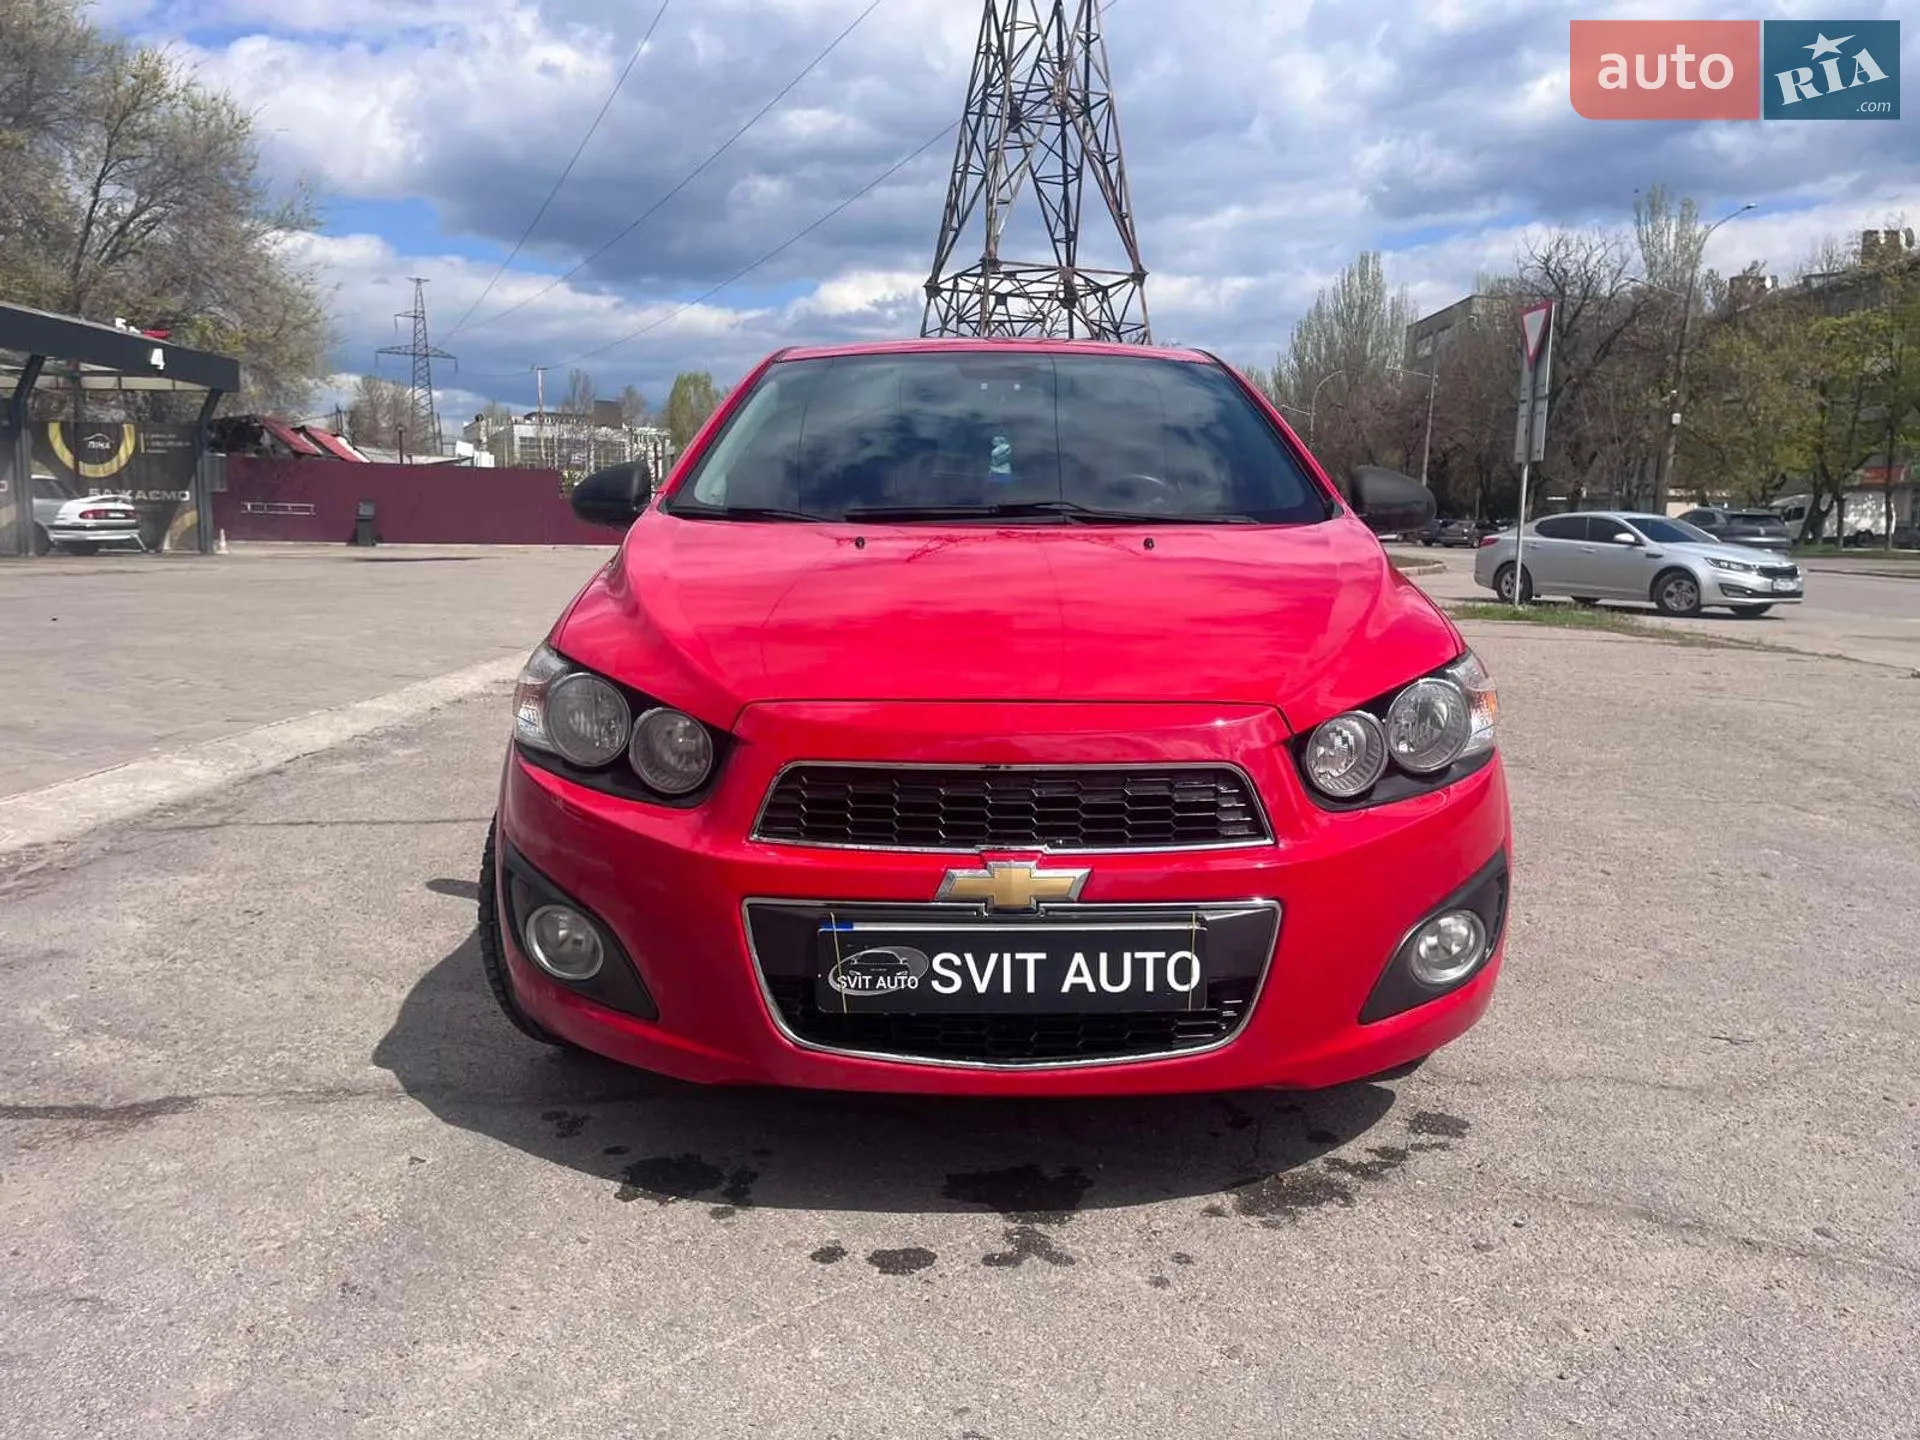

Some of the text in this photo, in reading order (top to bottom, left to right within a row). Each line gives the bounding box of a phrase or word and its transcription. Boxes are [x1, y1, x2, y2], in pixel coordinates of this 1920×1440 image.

[837, 975, 919, 990] SVIT AUTO
[931, 951, 1201, 994] SVIT AUTO
